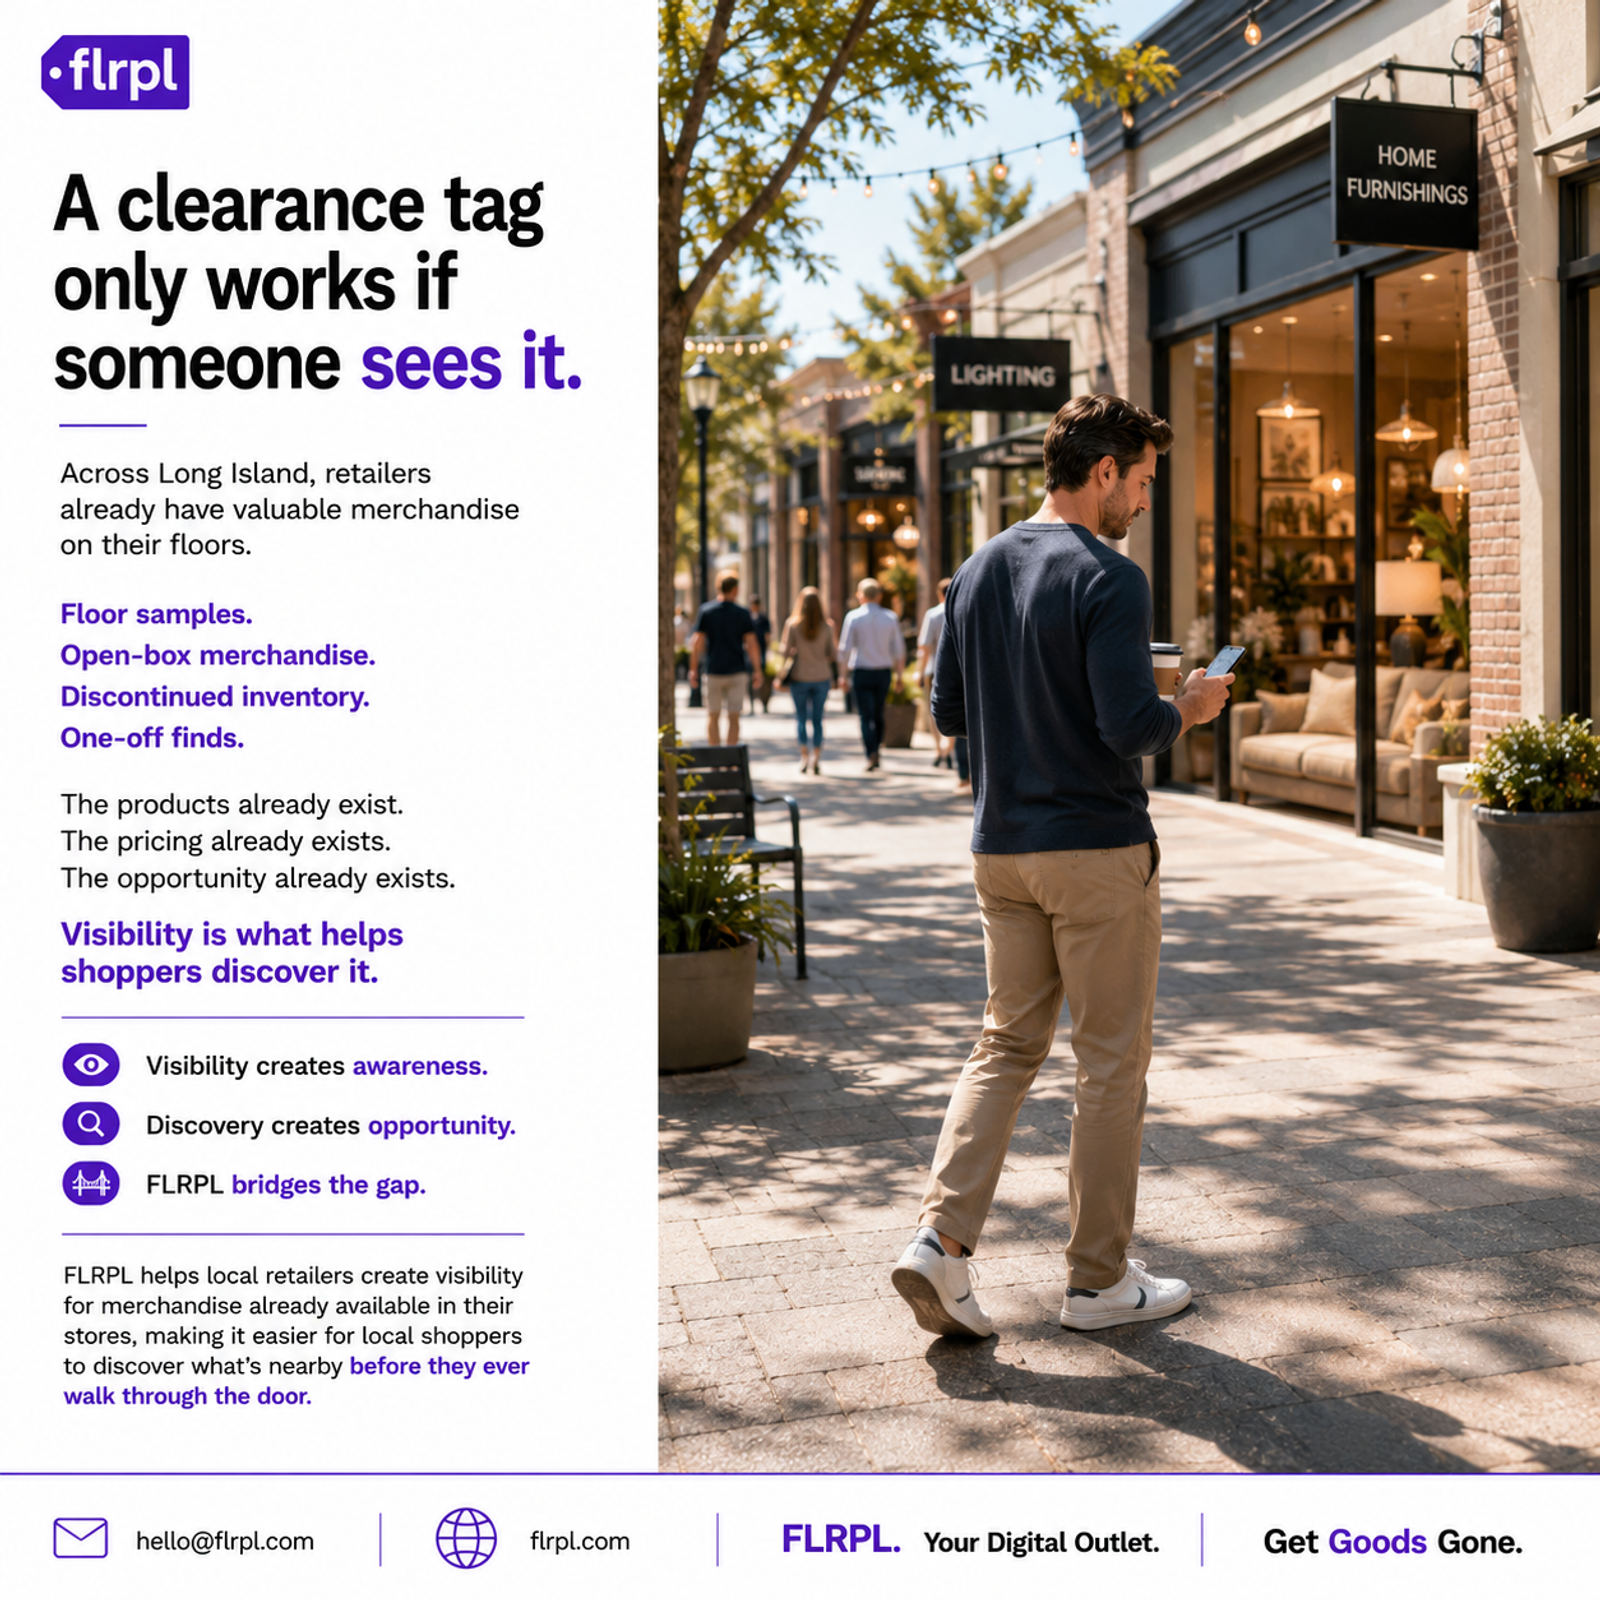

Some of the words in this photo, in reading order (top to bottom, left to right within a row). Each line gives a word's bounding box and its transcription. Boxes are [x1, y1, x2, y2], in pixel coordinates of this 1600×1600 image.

[1377, 144, 1438, 170] HOME
[1346, 177, 1469, 207] FURNISHINGS
[950, 363, 1057, 388] LIGHTING
